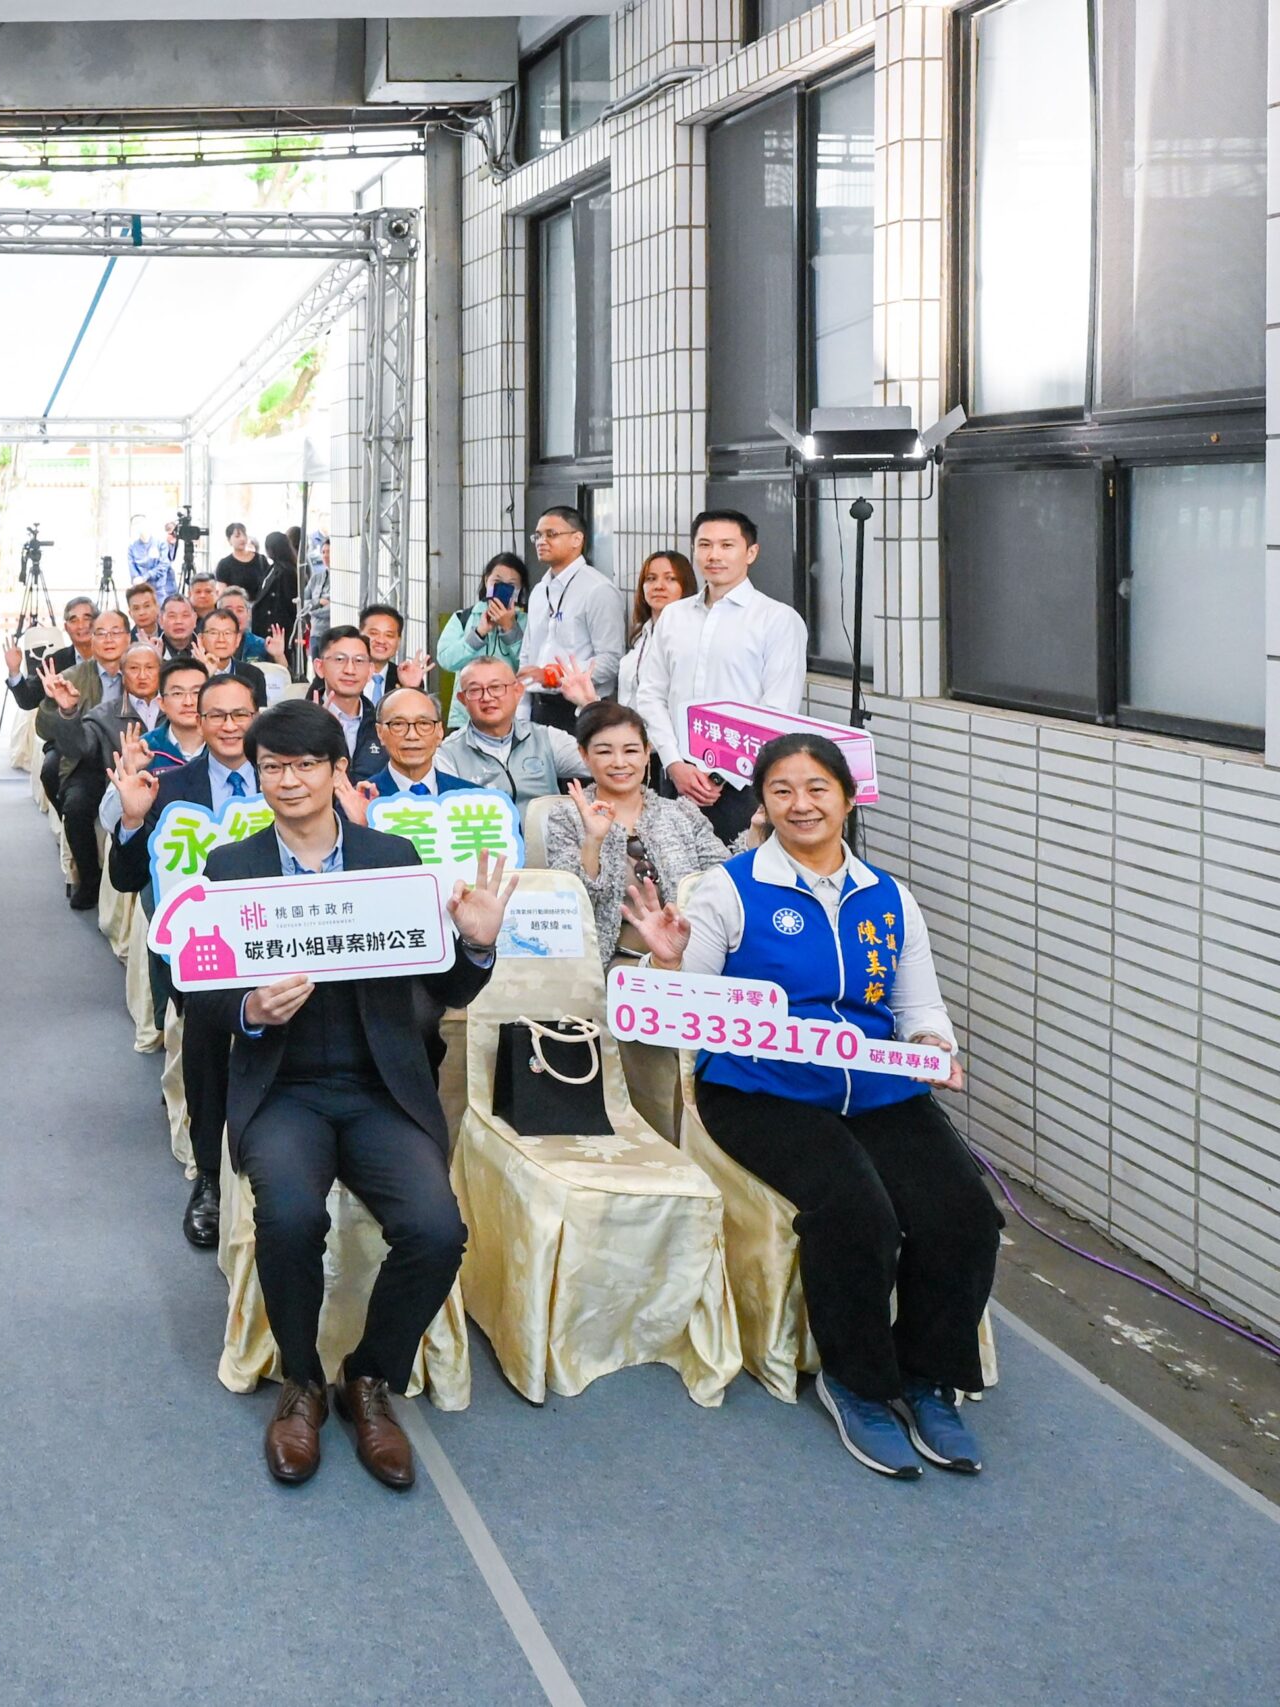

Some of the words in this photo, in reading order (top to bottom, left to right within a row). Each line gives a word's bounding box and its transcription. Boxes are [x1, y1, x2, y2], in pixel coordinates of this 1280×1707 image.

[693, 718, 767, 757] #淨零行
[382, 804, 508, 864] 產業
[275, 902, 354, 920] 桃園市政府
[244, 928, 427, 961] 碳費小組專案辦公室
[857, 919, 888, 1005] 陳美梅
[614, 1003, 860, 1061] 03-3332170
[868, 1048, 941, 1072] 碳費專線
